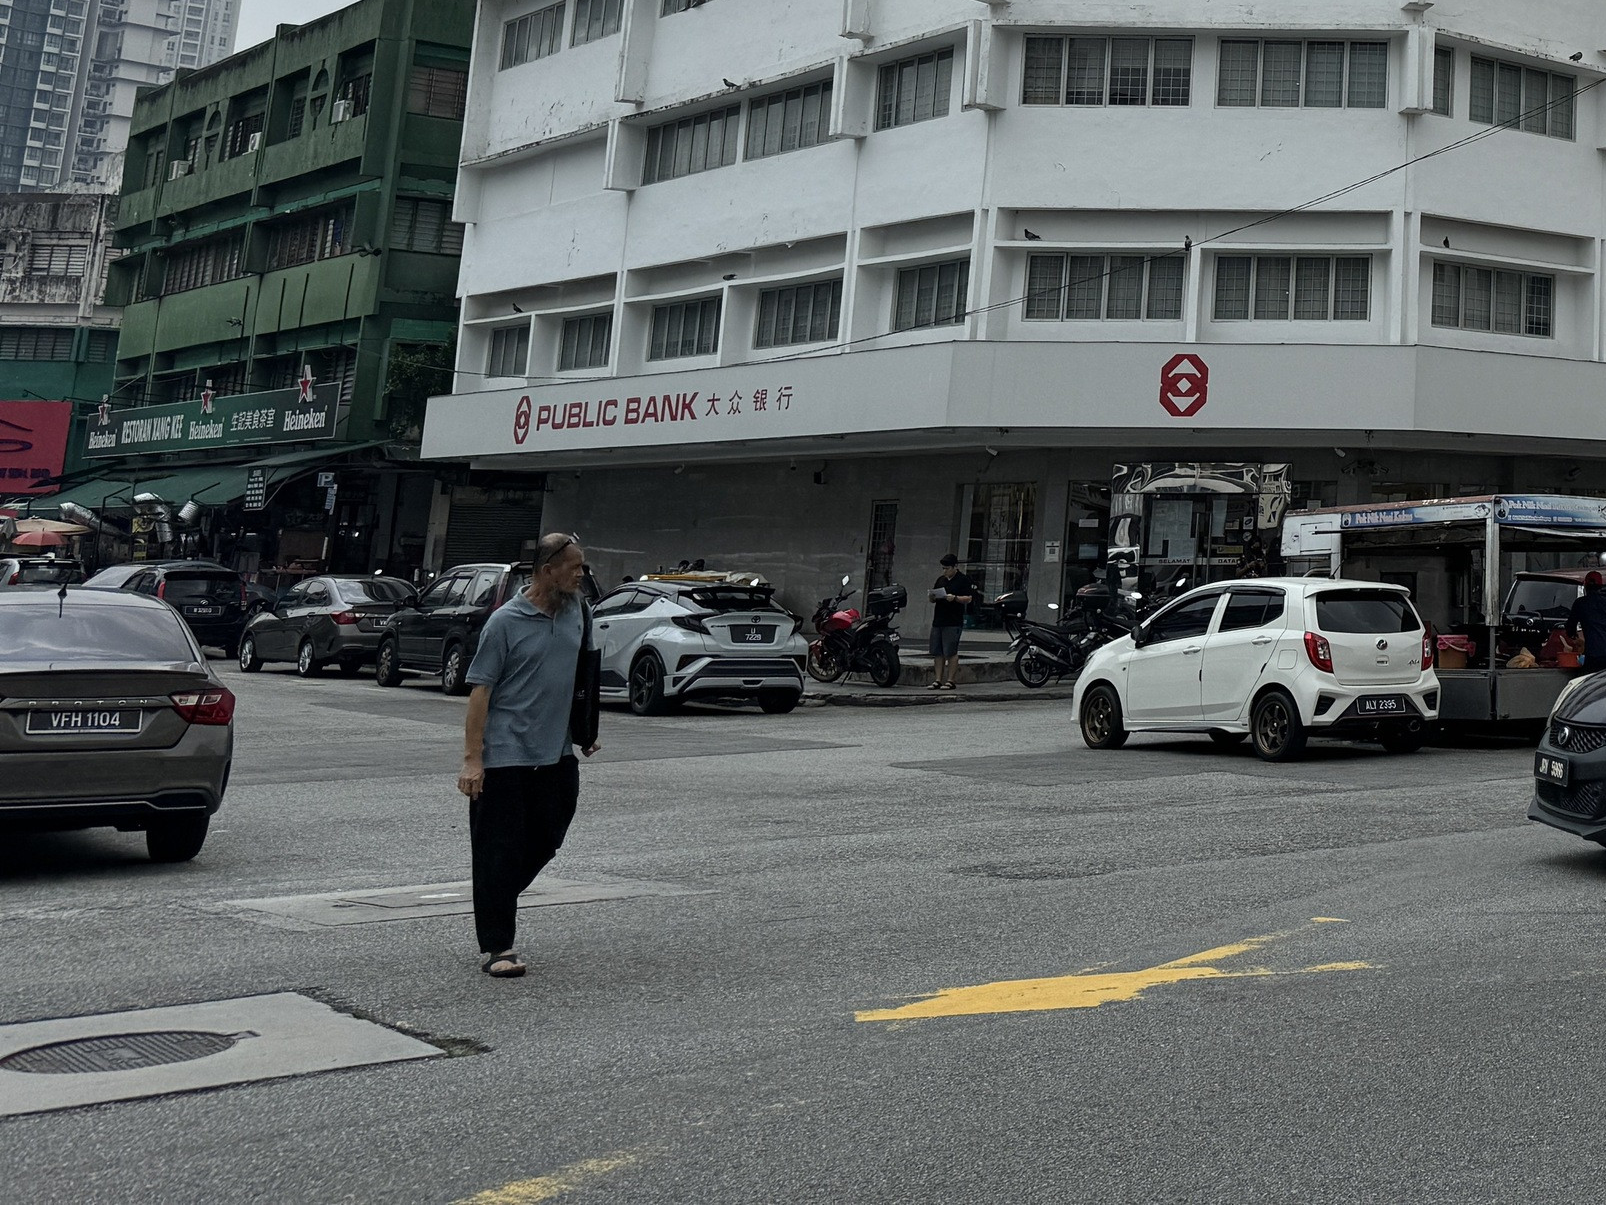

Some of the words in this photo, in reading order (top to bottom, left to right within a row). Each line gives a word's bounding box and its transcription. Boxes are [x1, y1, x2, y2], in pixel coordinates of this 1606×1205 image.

[536, 399, 618, 431] PUBLIC
[624, 392, 699, 425] BANK
[705, 386, 793, 417] 大众银行
[121, 419, 152, 444] RESTORAN
[170, 414, 185, 438] KEE
[188, 419, 224, 440] Heineken
[283, 409, 328, 431] Heineken
[88, 430, 117, 449] Heineken
[51, 712, 82, 727] VFH
[87, 711, 120, 727] 1104
